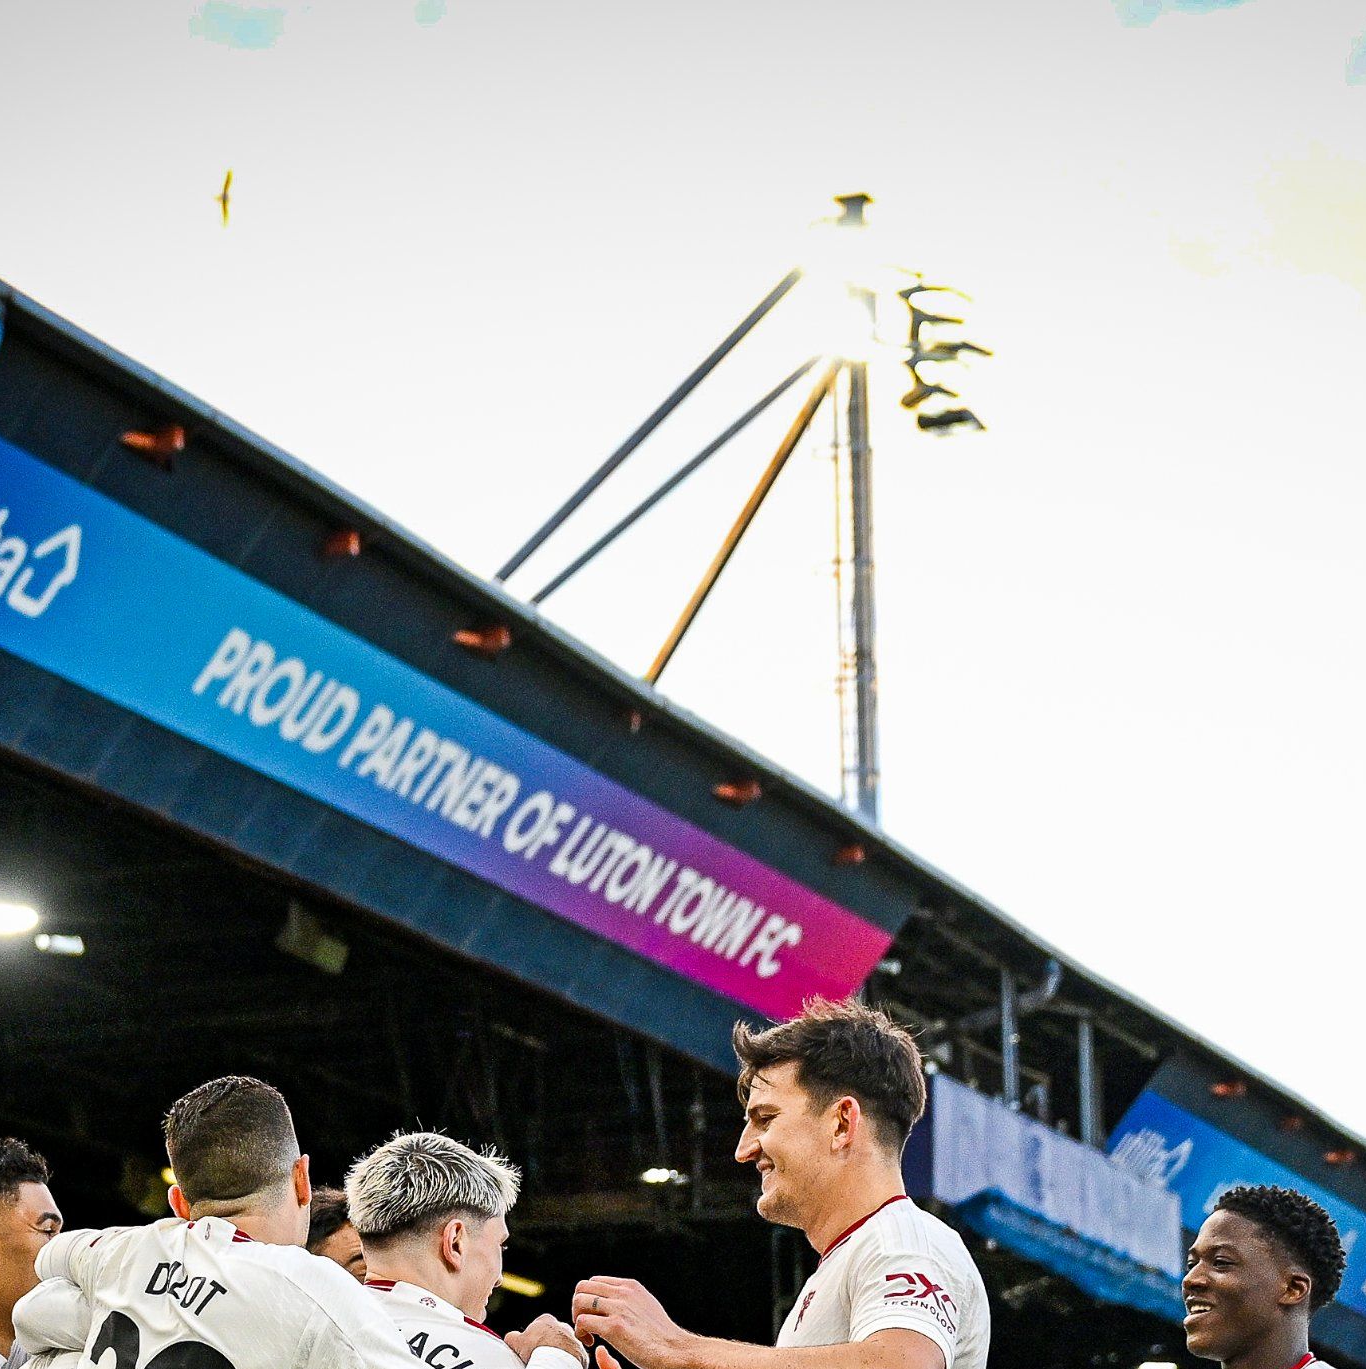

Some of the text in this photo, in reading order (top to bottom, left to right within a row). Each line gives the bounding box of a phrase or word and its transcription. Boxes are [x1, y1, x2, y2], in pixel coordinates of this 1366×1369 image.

[192, 627, 803, 978] PROUD PARTNER OF LUTON TOWN FC
